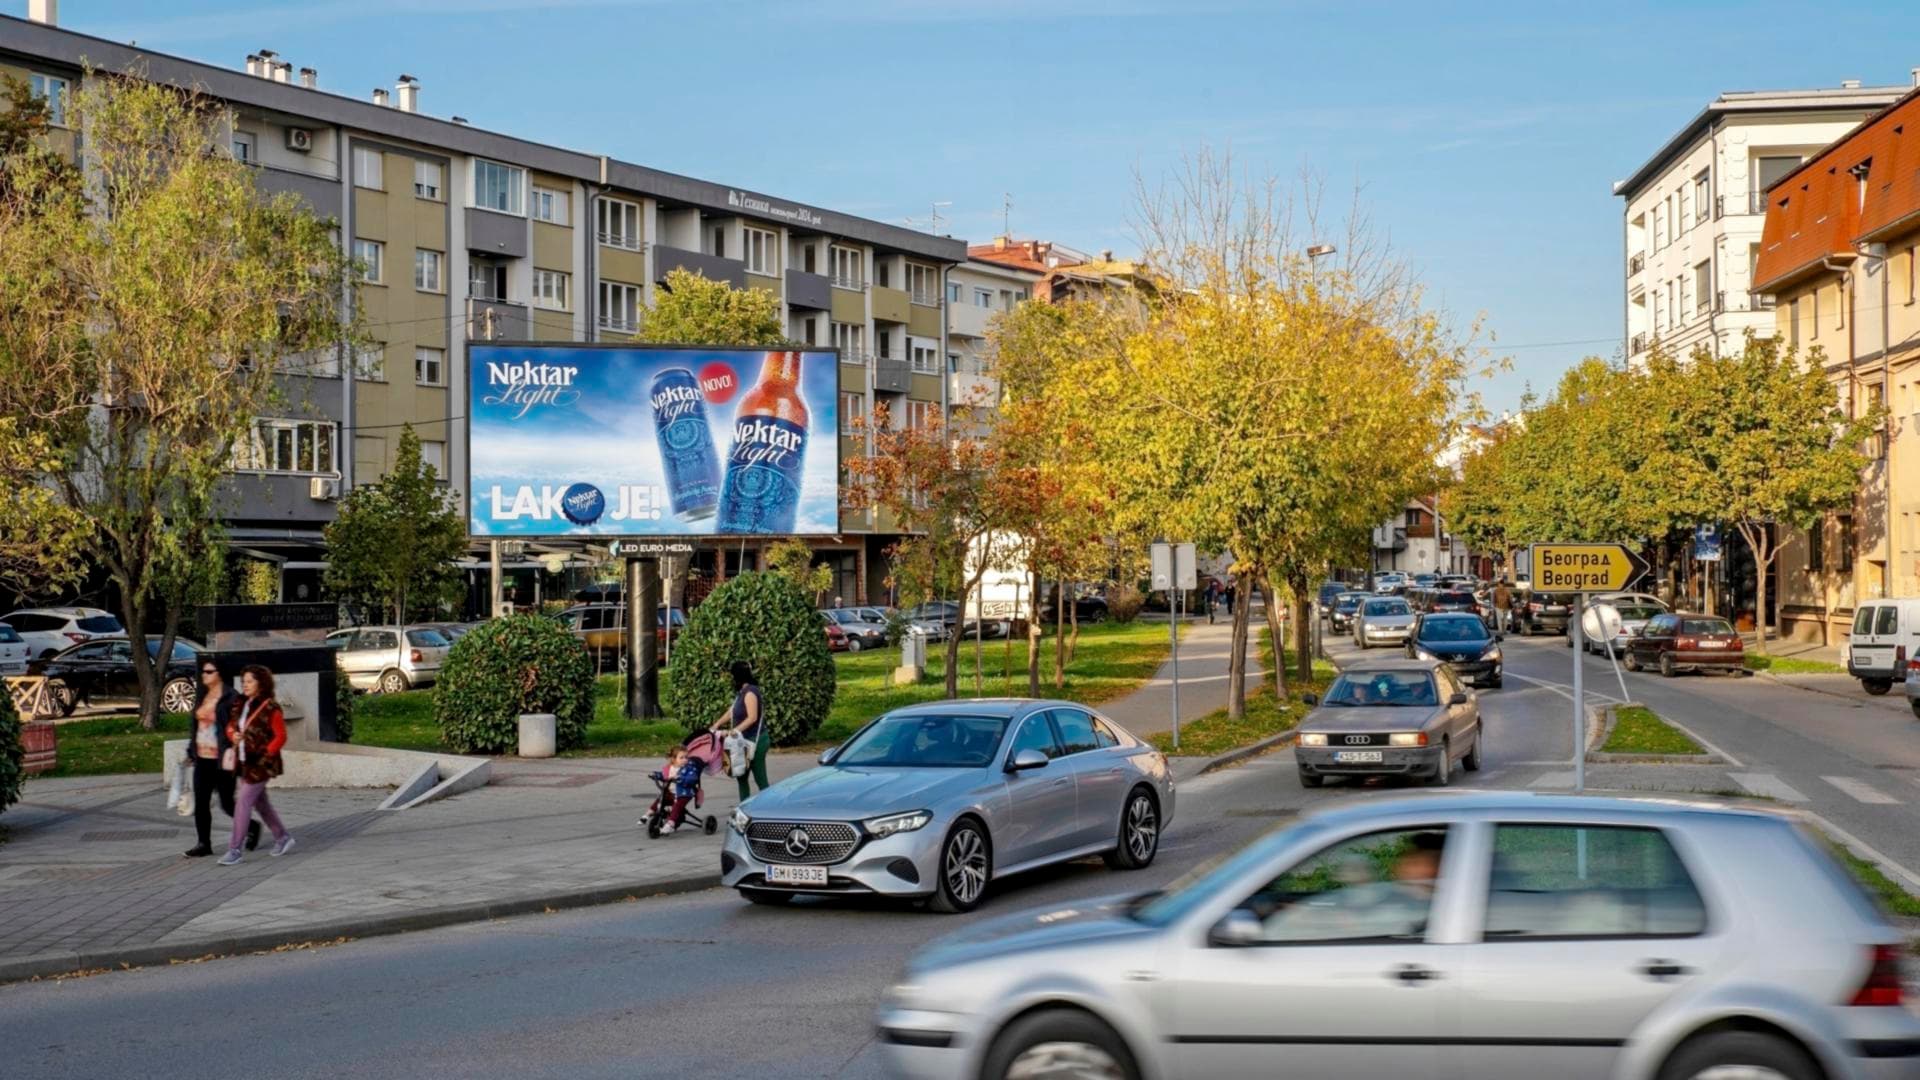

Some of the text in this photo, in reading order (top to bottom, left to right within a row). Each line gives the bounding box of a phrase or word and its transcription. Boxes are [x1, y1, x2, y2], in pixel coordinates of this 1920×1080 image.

[486, 360, 578, 386] Nektar
[703, 374, 733, 392] NOVO!
[483, 380, 581, 420] Light
[610, 485, 661, 520] JE!
[620, 544, 693, 552] LED EURO MEDIA
[1543, 550, 1611, 569] Београд
[1543, 569, 1609, 589] Beograd
